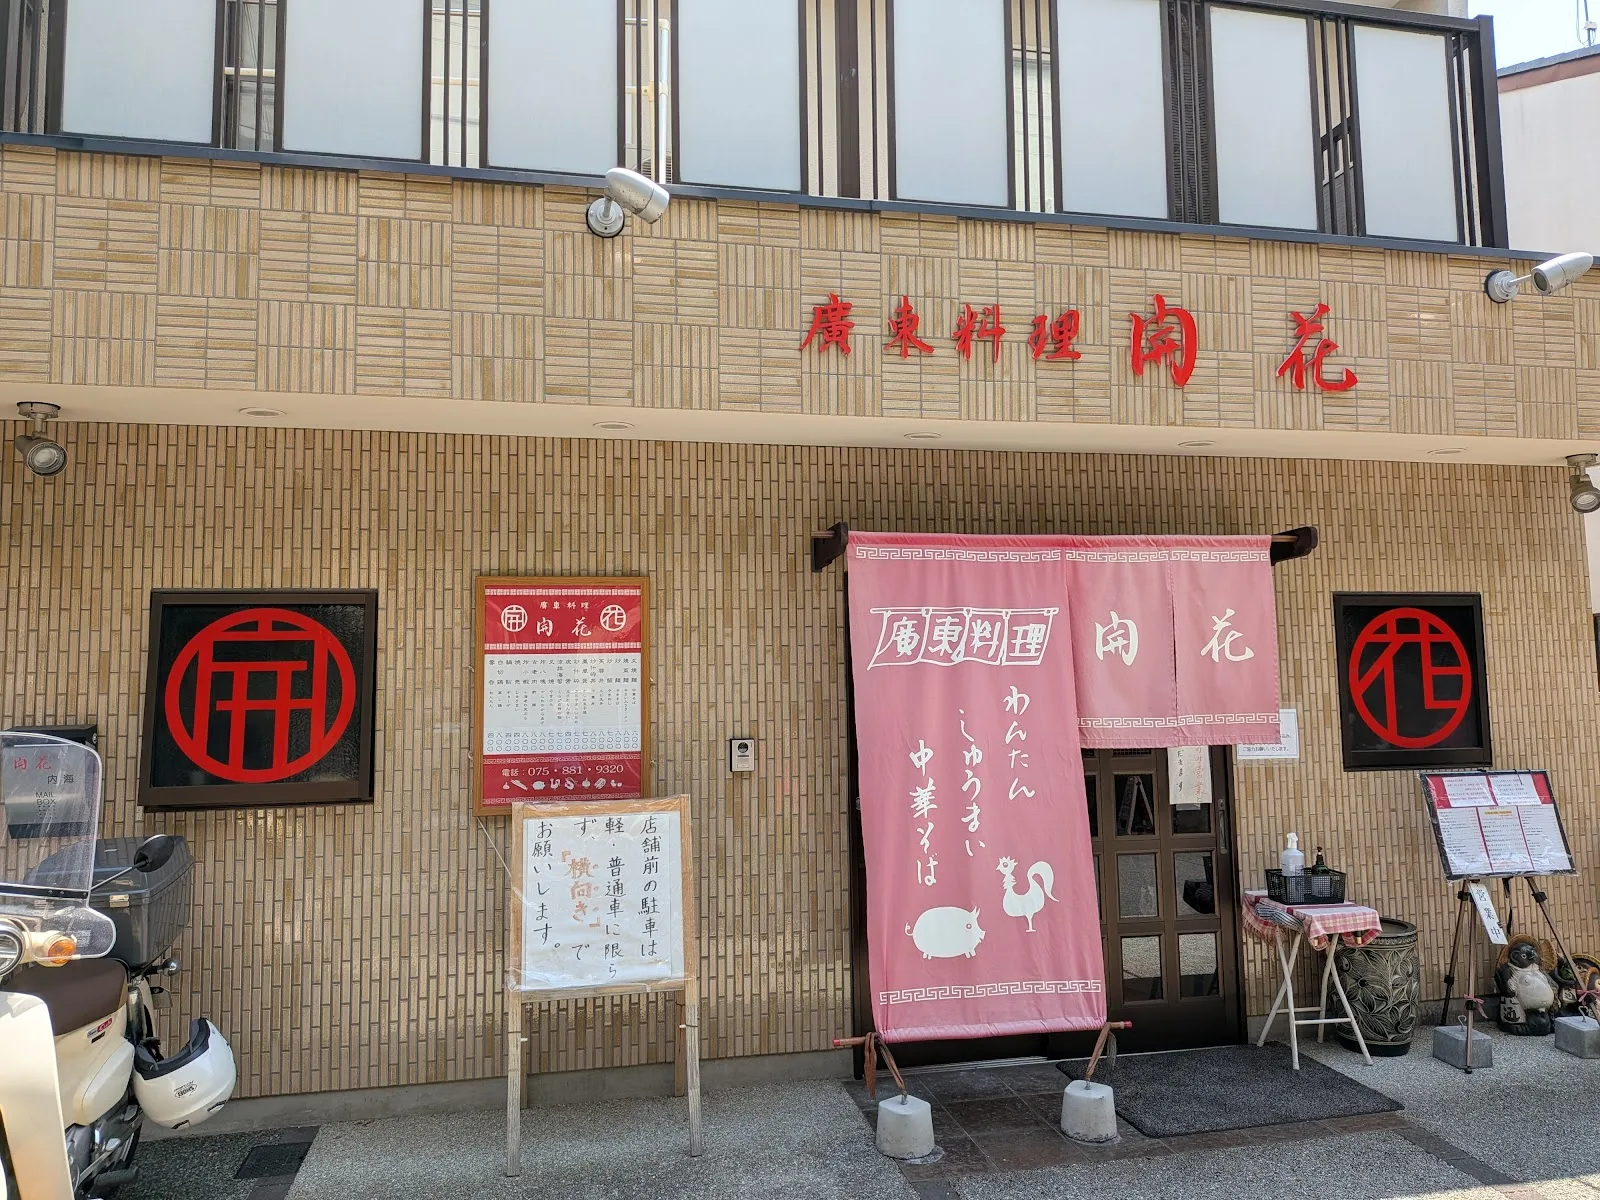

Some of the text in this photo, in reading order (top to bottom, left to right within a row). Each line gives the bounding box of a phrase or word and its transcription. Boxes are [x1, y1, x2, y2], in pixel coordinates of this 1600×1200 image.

[801, 293, 1358, 392] 廣東料理 開花
[537, 617, 592, 637] 開花
[890, 616, 1044, 659] 廣東料理
[1095, 608, 1255, 667] 開花
[47, 774, 74, 784] 内海
[958, 708, 987, 857] しゅうまい
[1003, 685, 1036, 800] わんたん
[908, 739, 939, 887] 中華そば
[532, 821, 561, 949] お願いします。
[639, 815, 661, 957] 店舗前の駐車は
